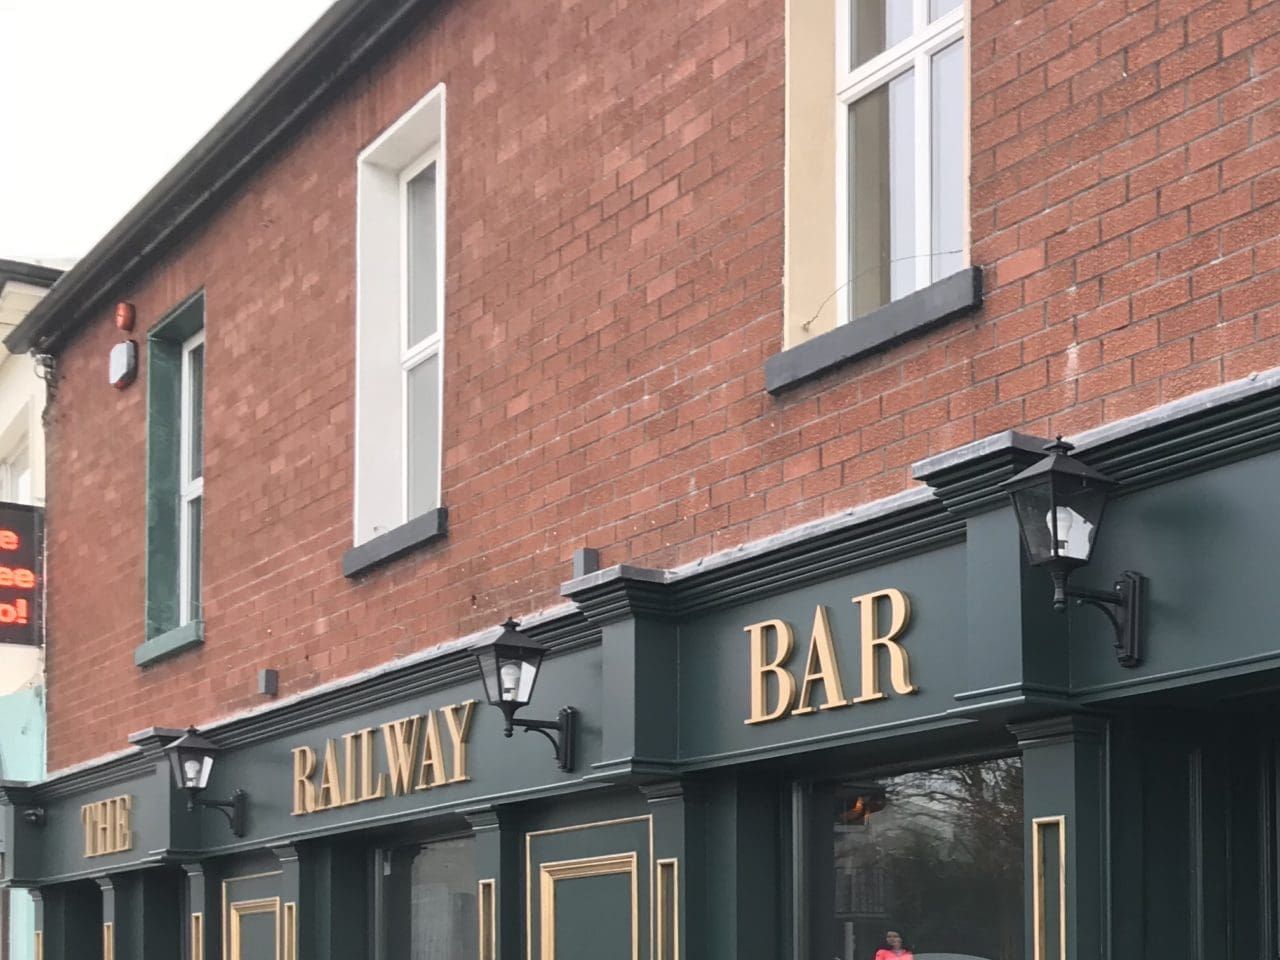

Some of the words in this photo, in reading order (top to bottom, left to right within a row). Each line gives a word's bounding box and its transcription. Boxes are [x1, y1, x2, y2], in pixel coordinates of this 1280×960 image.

[743, 587, 919, 725] BAR
[290, 699, 479, 816] RAILWAY
[81, 794, 133, 858] THE
